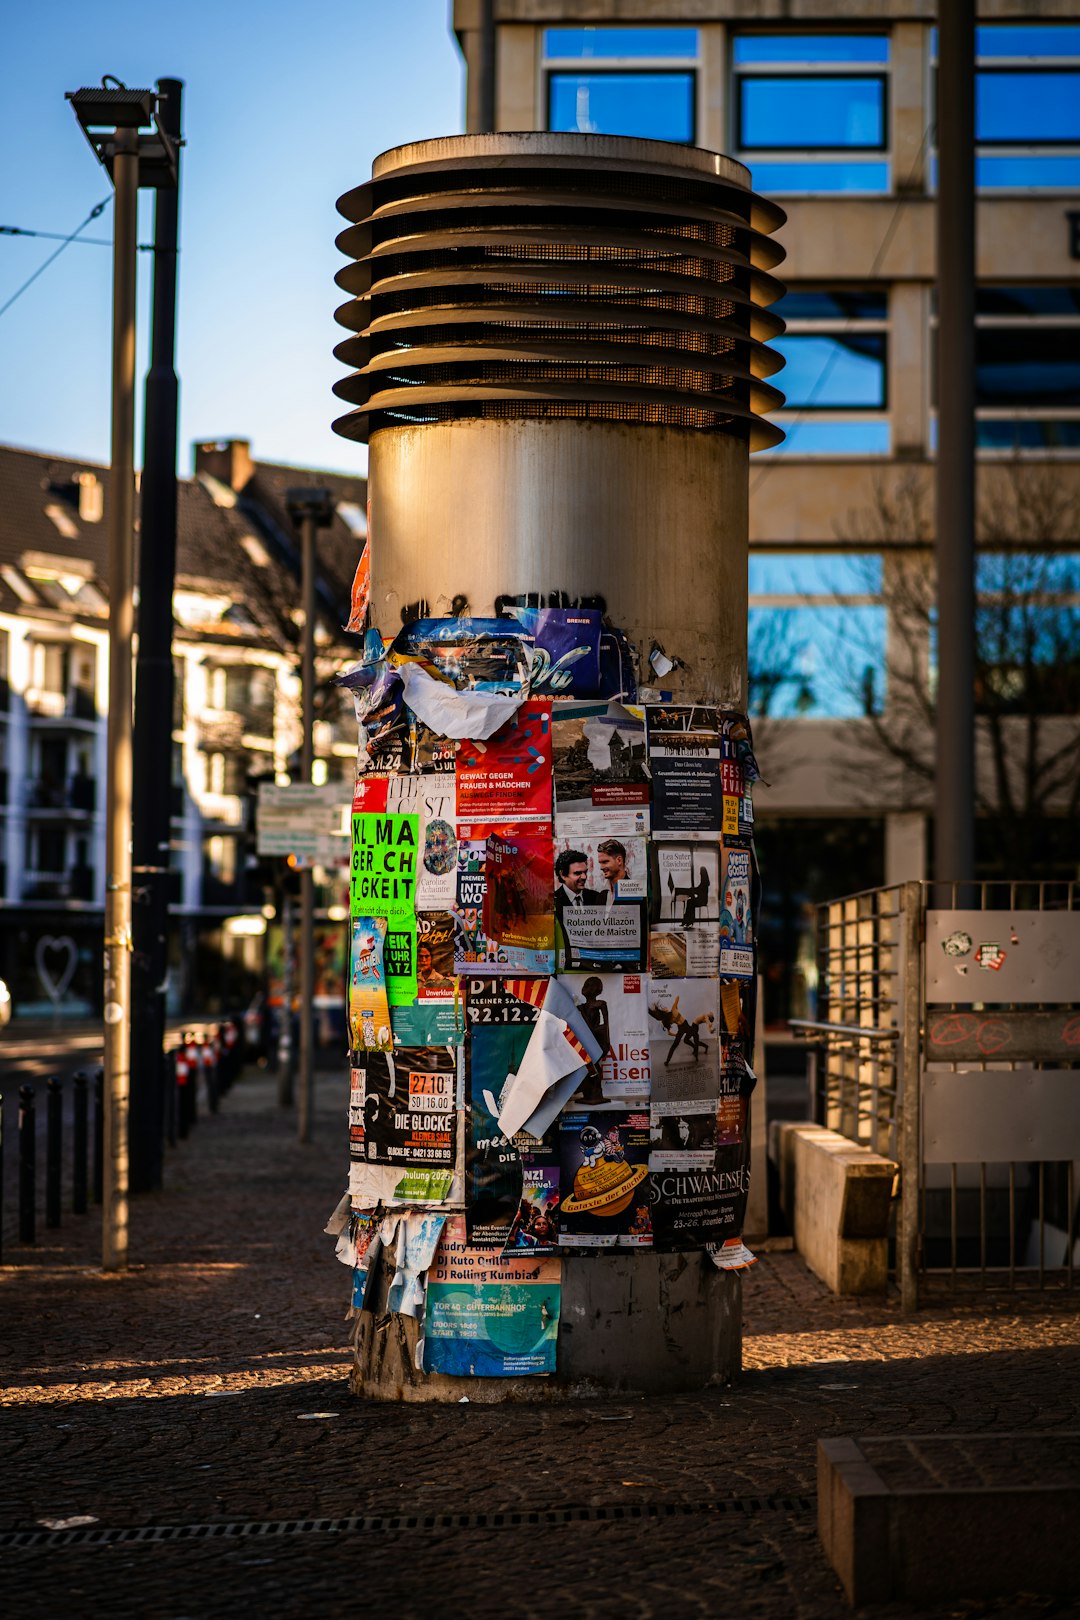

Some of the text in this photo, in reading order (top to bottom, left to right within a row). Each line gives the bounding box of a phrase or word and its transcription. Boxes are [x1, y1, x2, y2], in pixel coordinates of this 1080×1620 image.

[432, 752, 442, 760] DJ
[494, 842, 518, 854] Gelbe
[495, 854, 502, 863] Ei
[460, 893, 483, 904] WO
[390, 906, 407, 915] dich.
[567, 917, 635, 926] Rolando Villazón
[594, 928, 605, 936] de
[606, 927, 637, 936] Maistre
[416, 928, 454, 947] jetzt!
[502, 932, 536, 943] Farbenrausch
[391, 950, 410, 961] UHR
[601, 1044, 650, 1061] Alles
[601, 1062, 650, 1080] Eisen
[412, 1075, 448, 1094] 27.10.
[412, 1096, 448, 1109] SO 16.00
[394, 1114, 452, 1132] DIE GLOCKE
[411, 1131, 451, 1142] KLEINER SAAL
[412, 1148, 426, 1158] 0421
[426, 1149, 434, 1158] 33
[434, 1149, 442, 1158] 66
[442, 1150, 451, 1159] 99
[499, 1152, 516, 1163] DIE
[567, 1199, 602, 1211] Galaxie
[605, 1192, 620, 1202] der
[621, 1170, 646, 1193] Bücher
[438, 1242, 467, 1252] Audry
[438, 1256, 474, 1266] DJ Kuto
[437, 1270, 538, 1281] DJ Rolling Kumbias
[466, 1302, 526, 1312] GÜTERBAHNHOF
